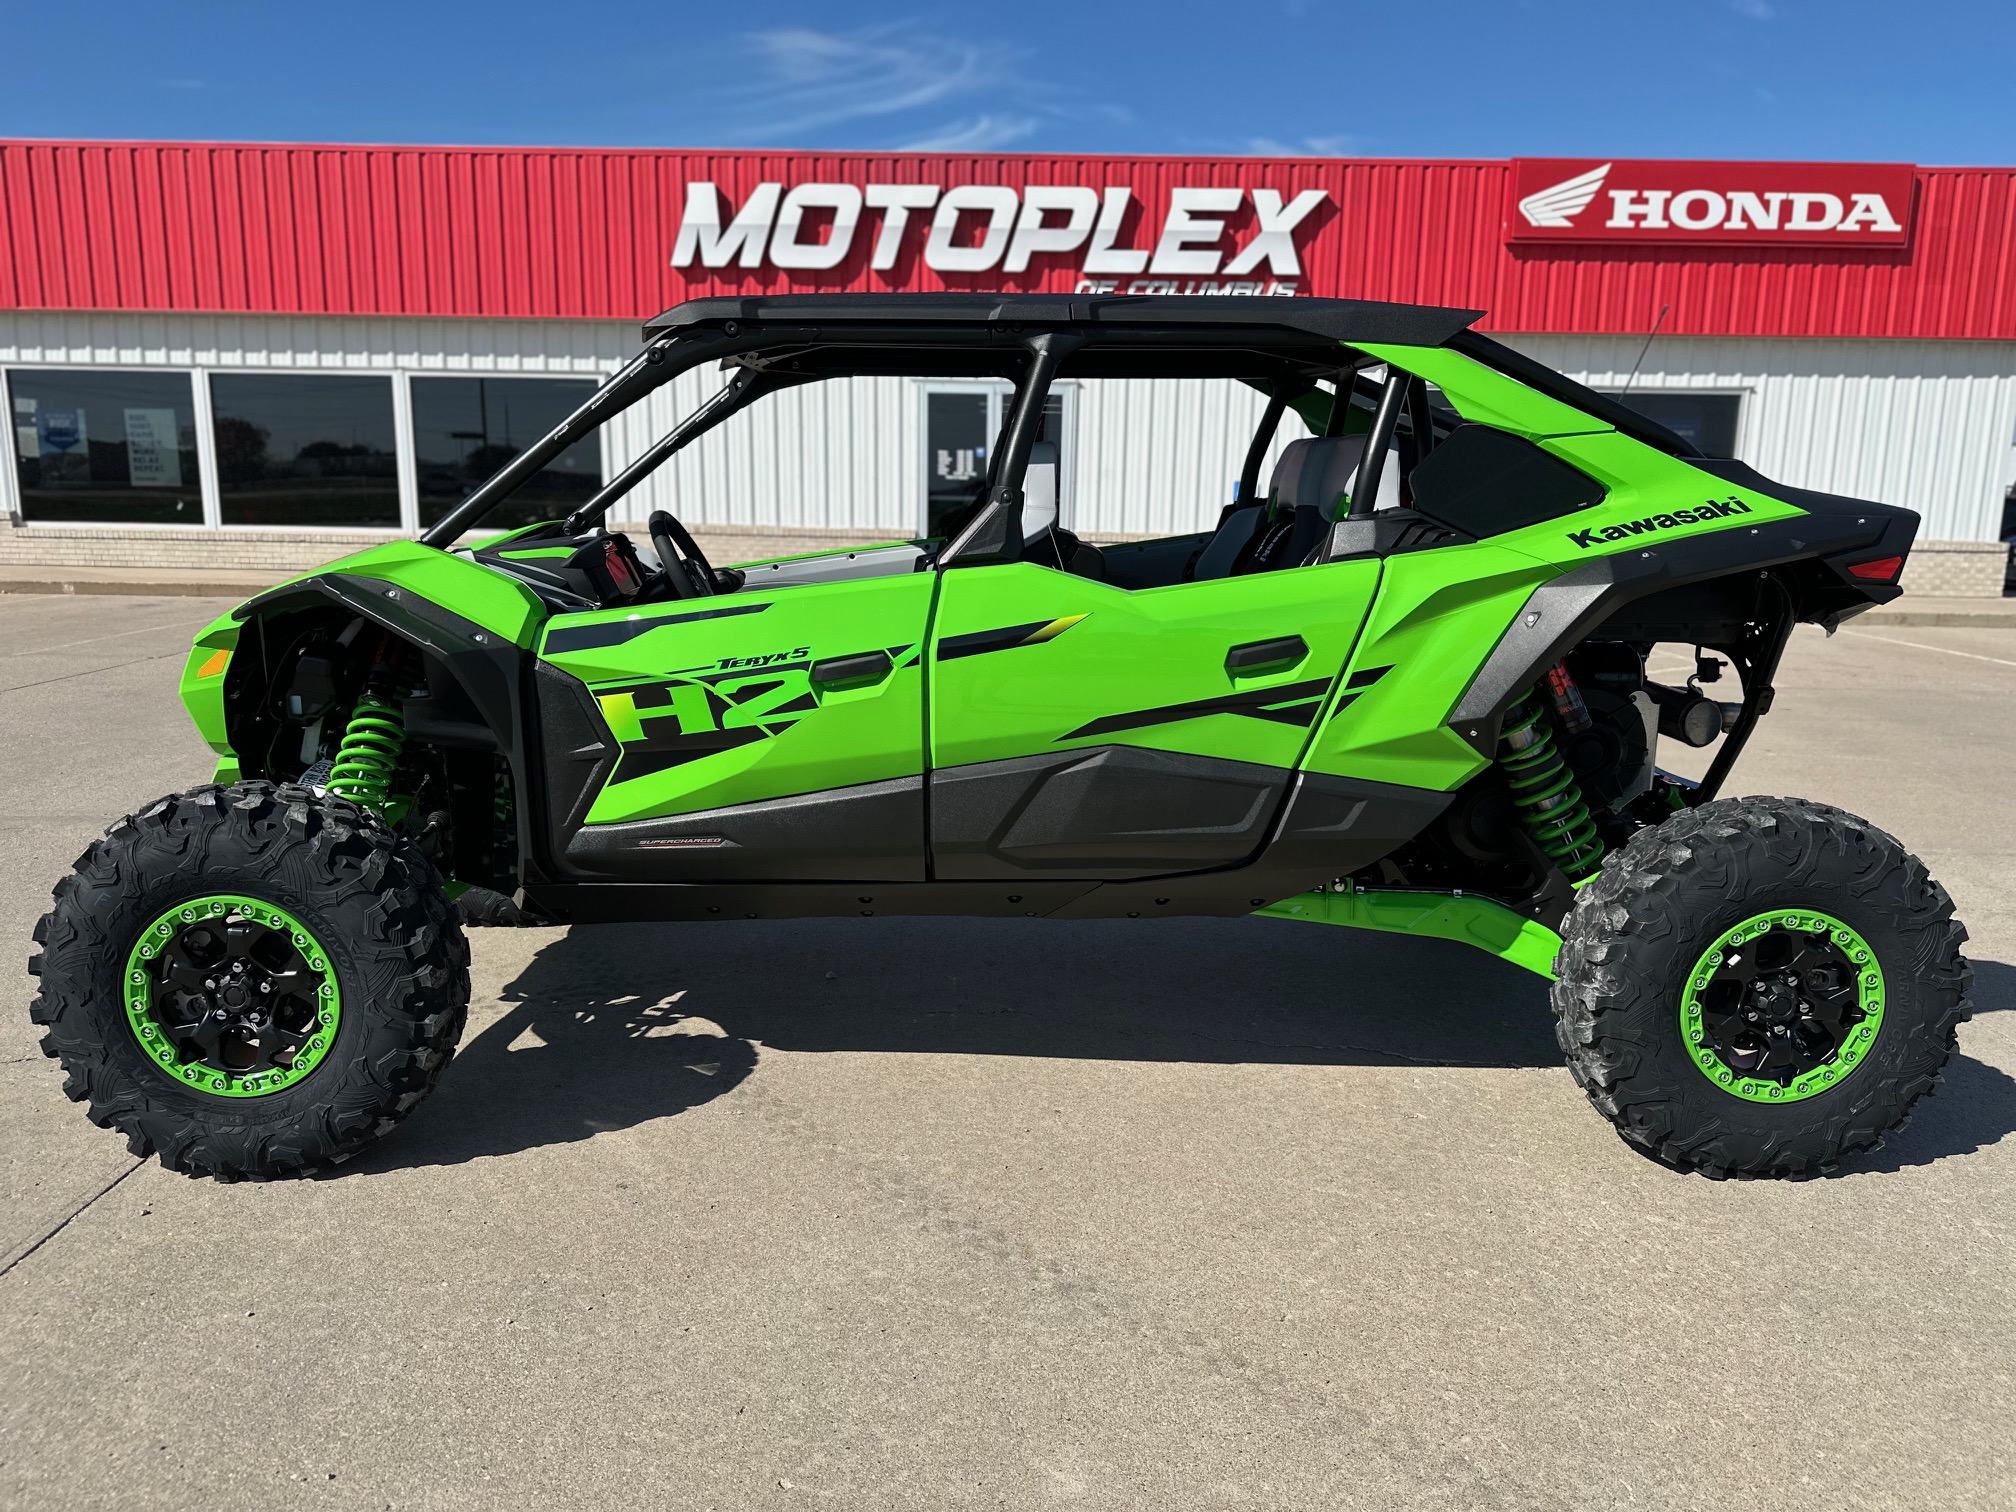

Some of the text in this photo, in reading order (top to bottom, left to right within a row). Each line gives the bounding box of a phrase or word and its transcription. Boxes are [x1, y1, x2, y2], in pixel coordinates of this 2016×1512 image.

[671, 182, 1330, 276] MOTOPLEX
[1605, 189, 1902, 232] HONDA
[1074, 279, 1299, 297] OF COLUMBUS
[1565, 495, 1754, 549] Kawasaki
[597, 669, 821, 743] H2
[638, 837, 722, 845] SUPERCHARGED
